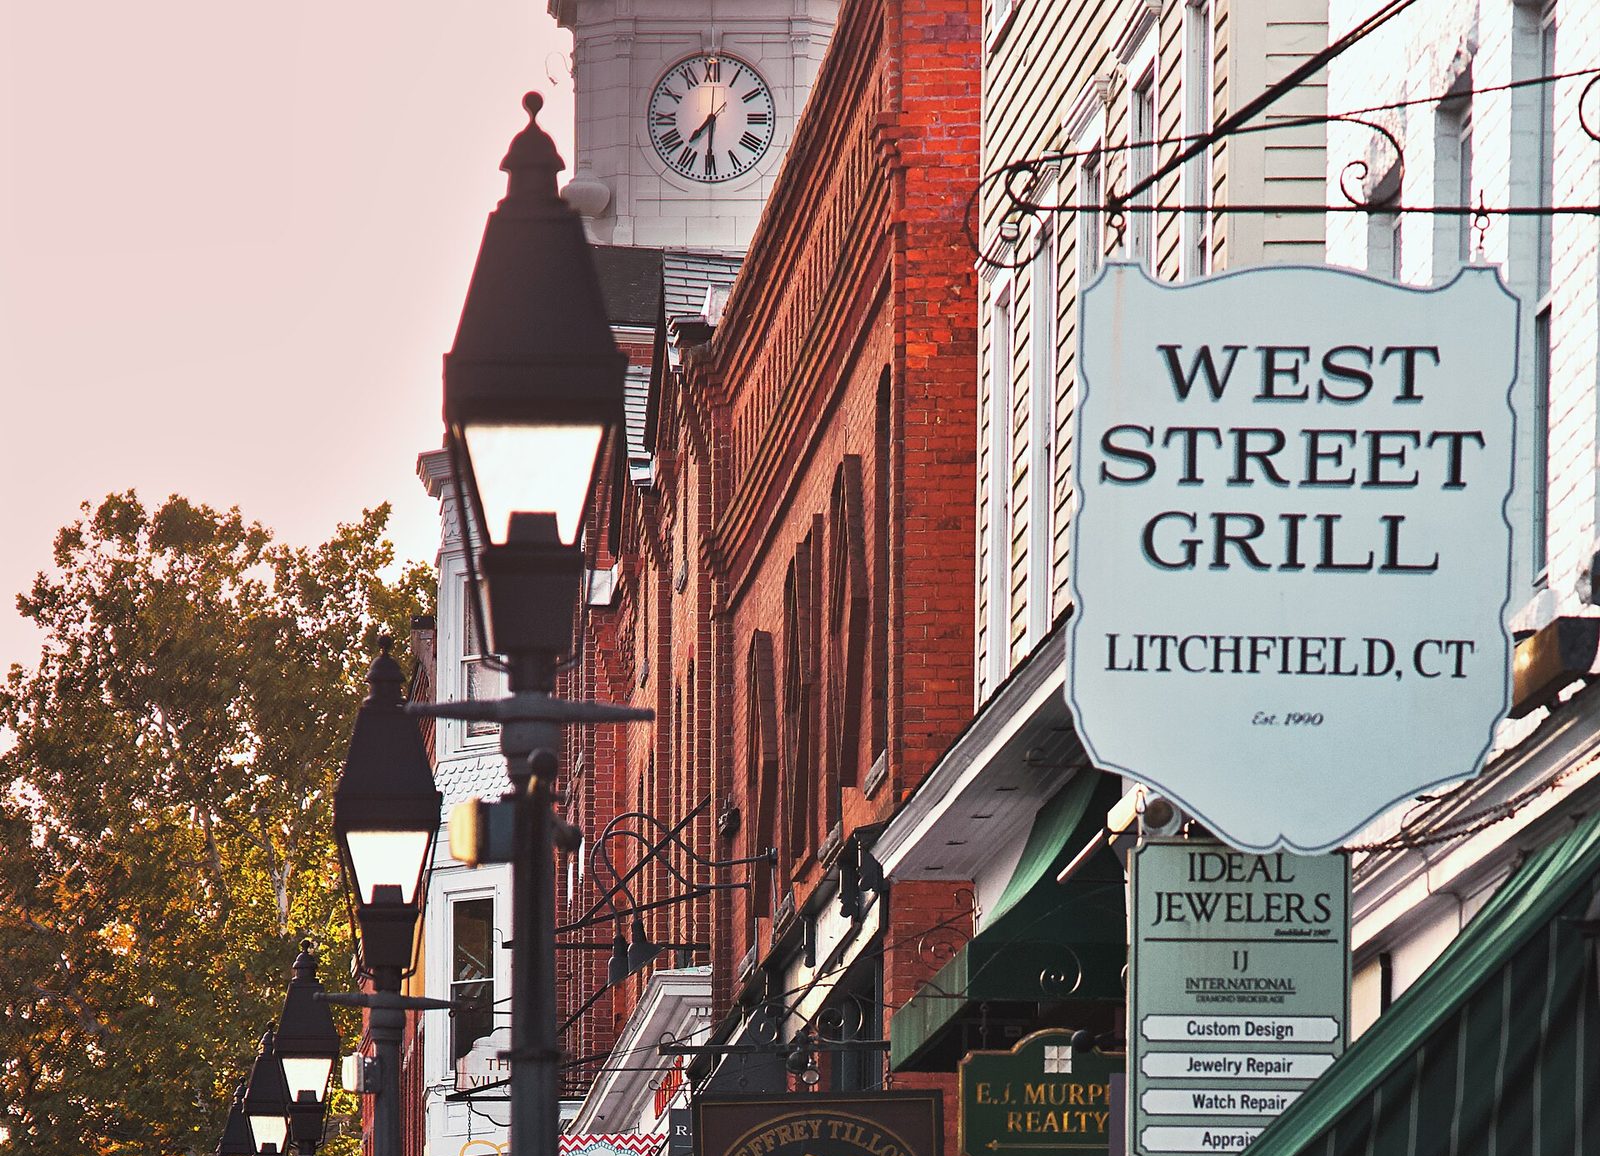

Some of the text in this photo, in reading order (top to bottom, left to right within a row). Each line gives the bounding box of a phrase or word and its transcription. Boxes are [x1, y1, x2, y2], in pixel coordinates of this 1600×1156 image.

[1157, 343, 1440, 405] WEST
[1099, 423, 1485, 490] STREET
[1140, 511, 1440, 576] GRILL
[1105, 633, 1475, 682] LITCHFIELD, CT
[1284, 712, 1324, 726] 1990
[1188, 852, 1296, 883] IDEAL
[1151, 891, 1332, 926] JEWELERS
[1233, 950, 1249, 973] IJ
[1185, 977, 1296, 991] INTERNATIONAL
[1187, 1020, 1294, 1040] Custom Design
[1187, 1057, 1293, 1076] Jewelry Repair
[976, 1082, 1017, 1105] E.J.
[1192, 1094, 1287, 1112] Watch Repair
[1007, 1111, 1109, 1133] REALTY
